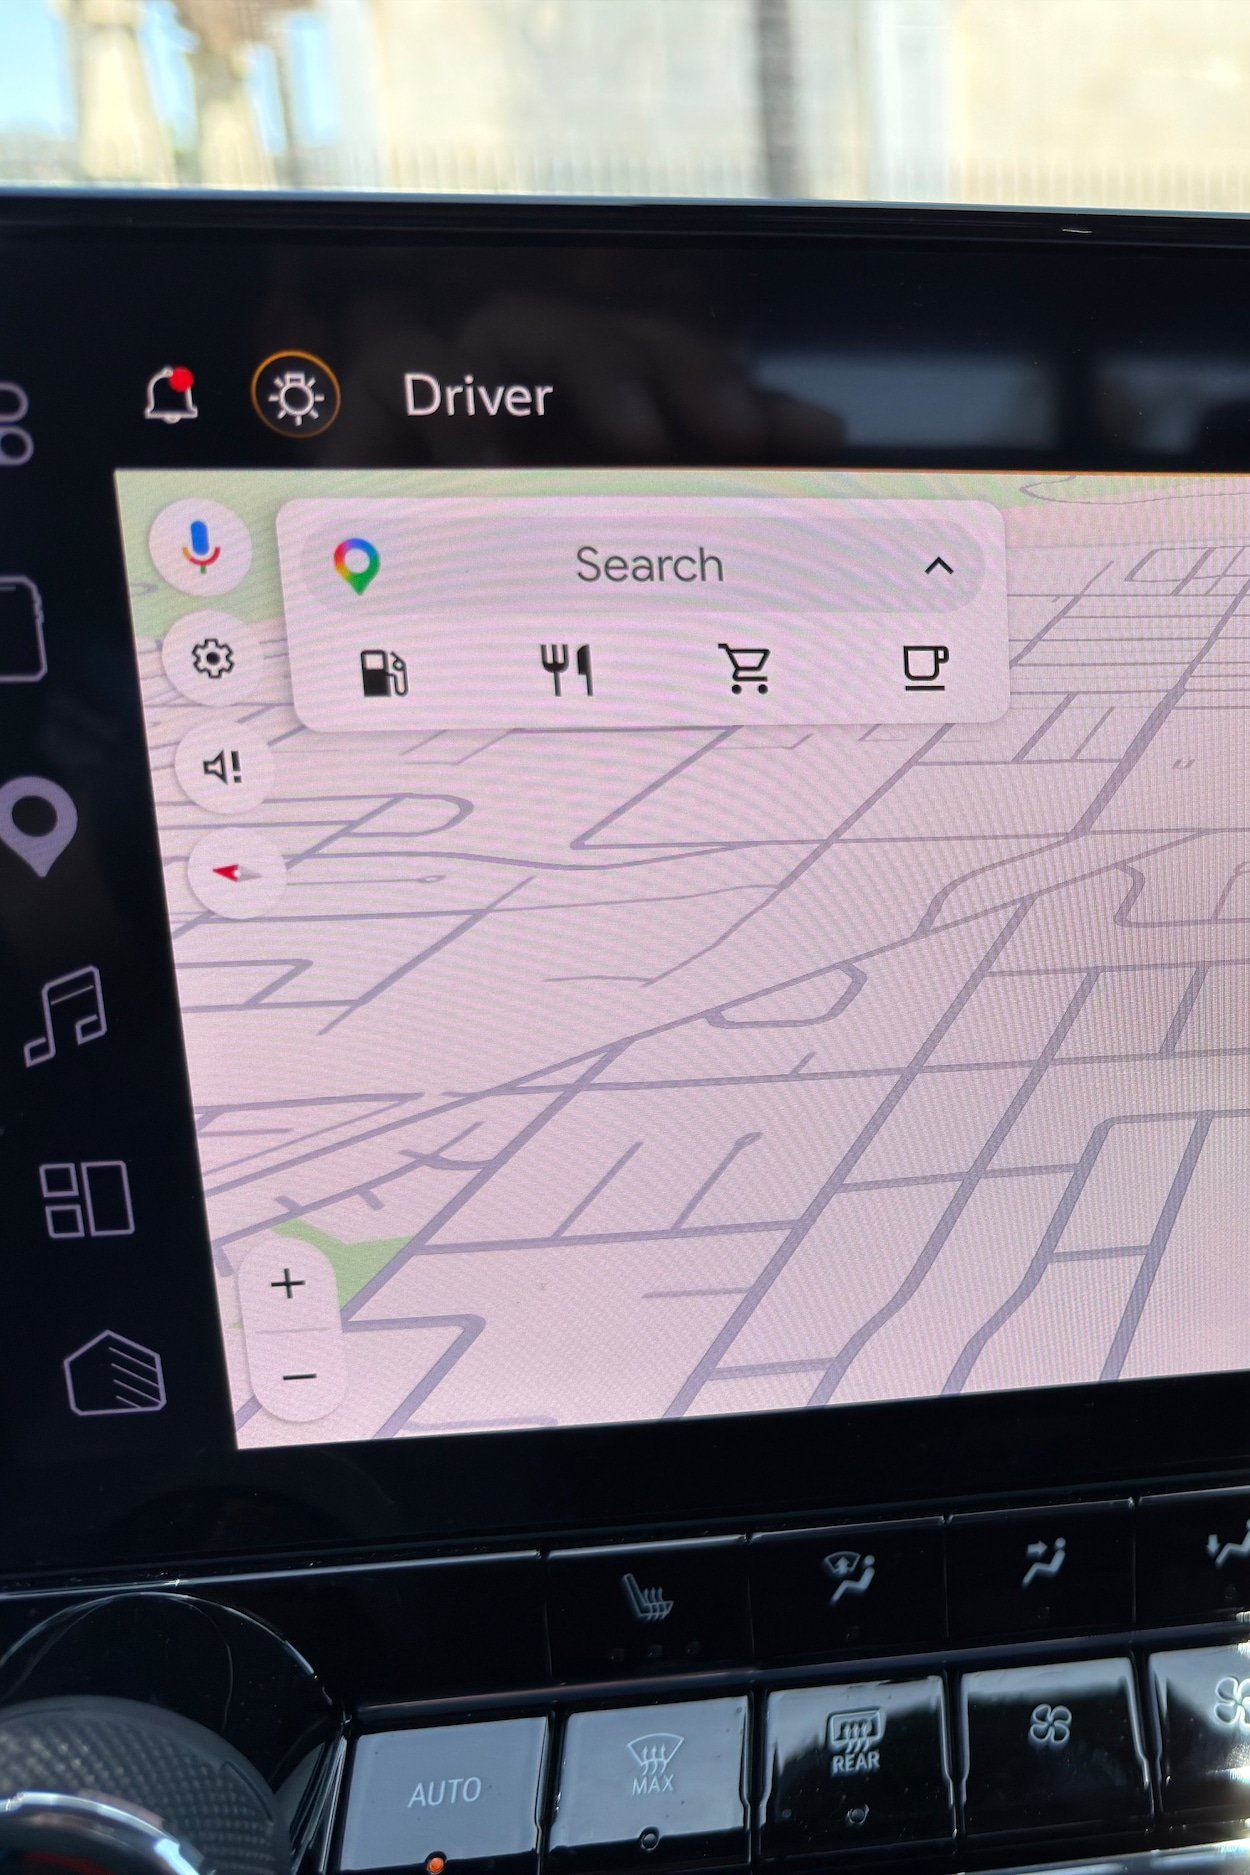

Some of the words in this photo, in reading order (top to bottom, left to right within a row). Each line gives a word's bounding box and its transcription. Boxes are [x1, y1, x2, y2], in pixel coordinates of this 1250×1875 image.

[404, 373, 553, 417] Driver
[576, 546, 725, 583] Search
[832, 1750, 880, 1775] REAR
[407, 1776, 482, 1810] AUTO
[632, 1773, 674, 1797] MAX
